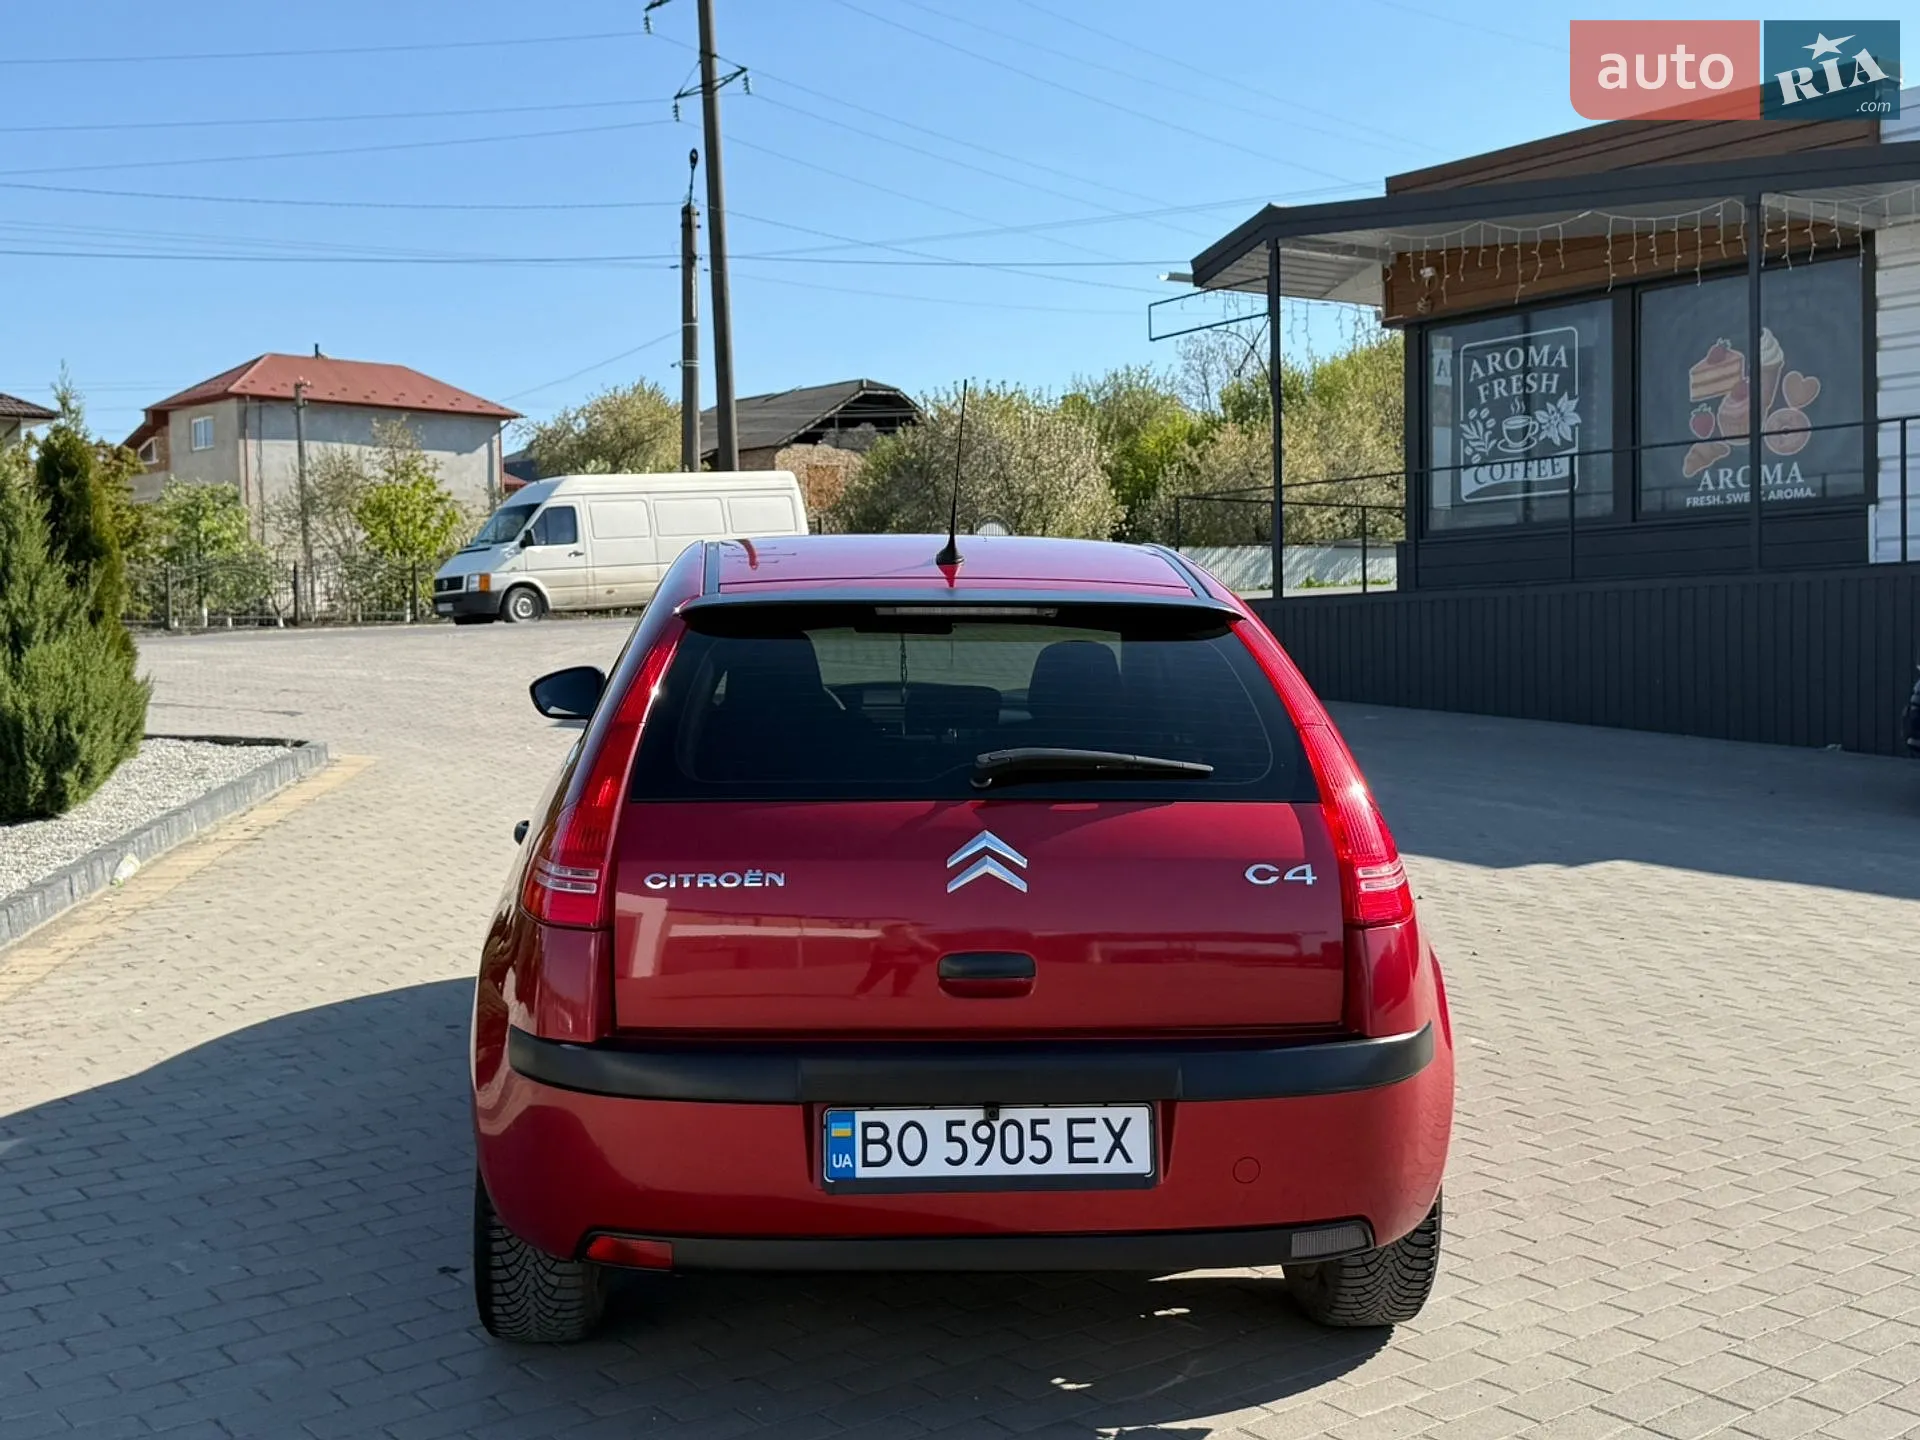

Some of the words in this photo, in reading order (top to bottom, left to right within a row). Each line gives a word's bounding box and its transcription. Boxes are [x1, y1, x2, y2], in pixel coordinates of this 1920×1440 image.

[1469, 344, 1568, 382] AROMA
[1478, 373, 1560, 404] FRESH
[1474, 458, 1563, 484] COFFEE
[1686, 495, 1724, 508] FRESH.
[1767, 487, 1816, 501] AROMA.
[643, 869, 785, 889] CITROËN
[1244, 863, 1318, 885] C4
[860, 1120, 928, 1168] BO
[944, 1117, 1052, 1166] 5905
[1067, 1116, 1133, 1164] EX
[832, 1153, 853, 1168] UA
